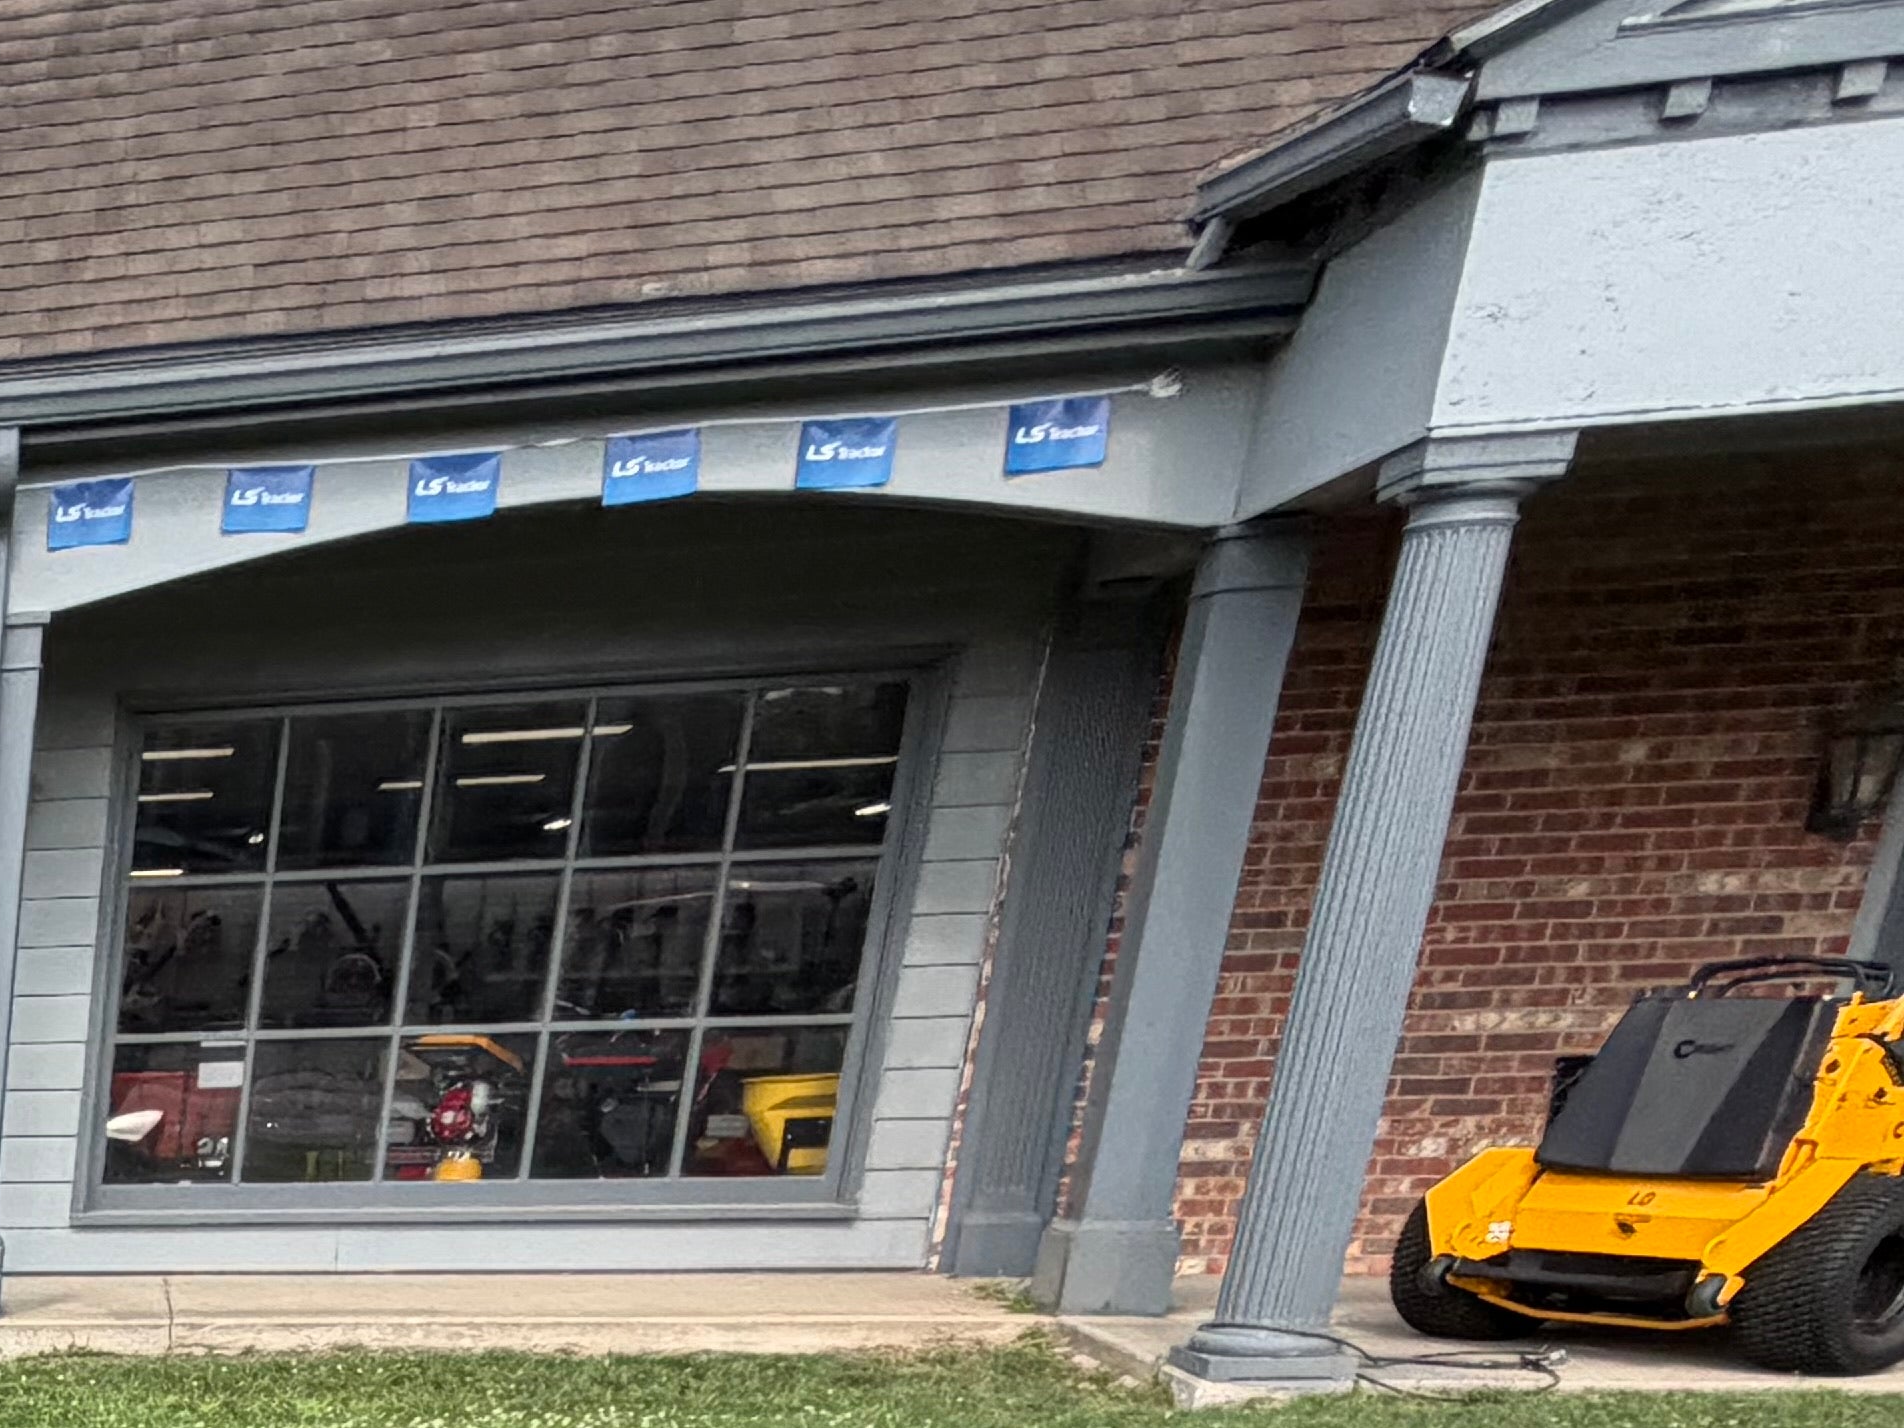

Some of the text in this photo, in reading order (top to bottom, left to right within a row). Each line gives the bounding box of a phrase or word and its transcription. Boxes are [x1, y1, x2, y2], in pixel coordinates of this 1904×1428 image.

[1014, 422, 1053, 444] LS
[805, 440, 842, 461] LS
[612, 455, 647, 478] LS
[230, 486, 265, 505] LS
[414, 476, 449, 497] LS
[55, 502, 86, 522] LS
